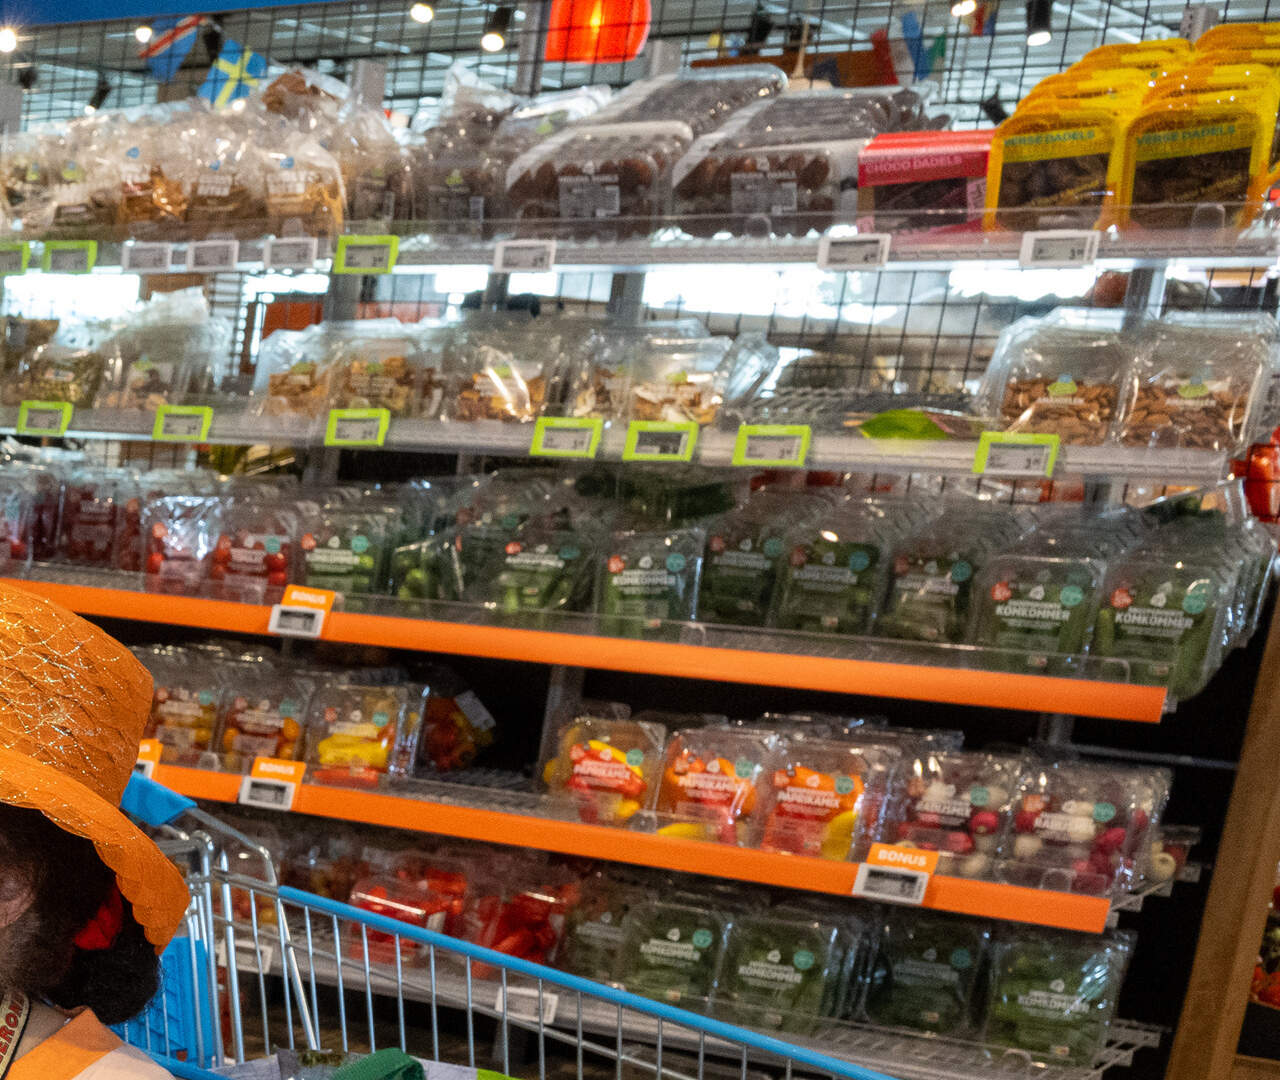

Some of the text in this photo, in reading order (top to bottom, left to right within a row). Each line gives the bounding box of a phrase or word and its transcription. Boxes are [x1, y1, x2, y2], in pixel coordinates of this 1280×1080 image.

[995, 604, 1071, 621] KOMKOMMER
[1115, 611, 1194, 629] KOMKOMMER
[877, 849, 927, 867] BONUS
